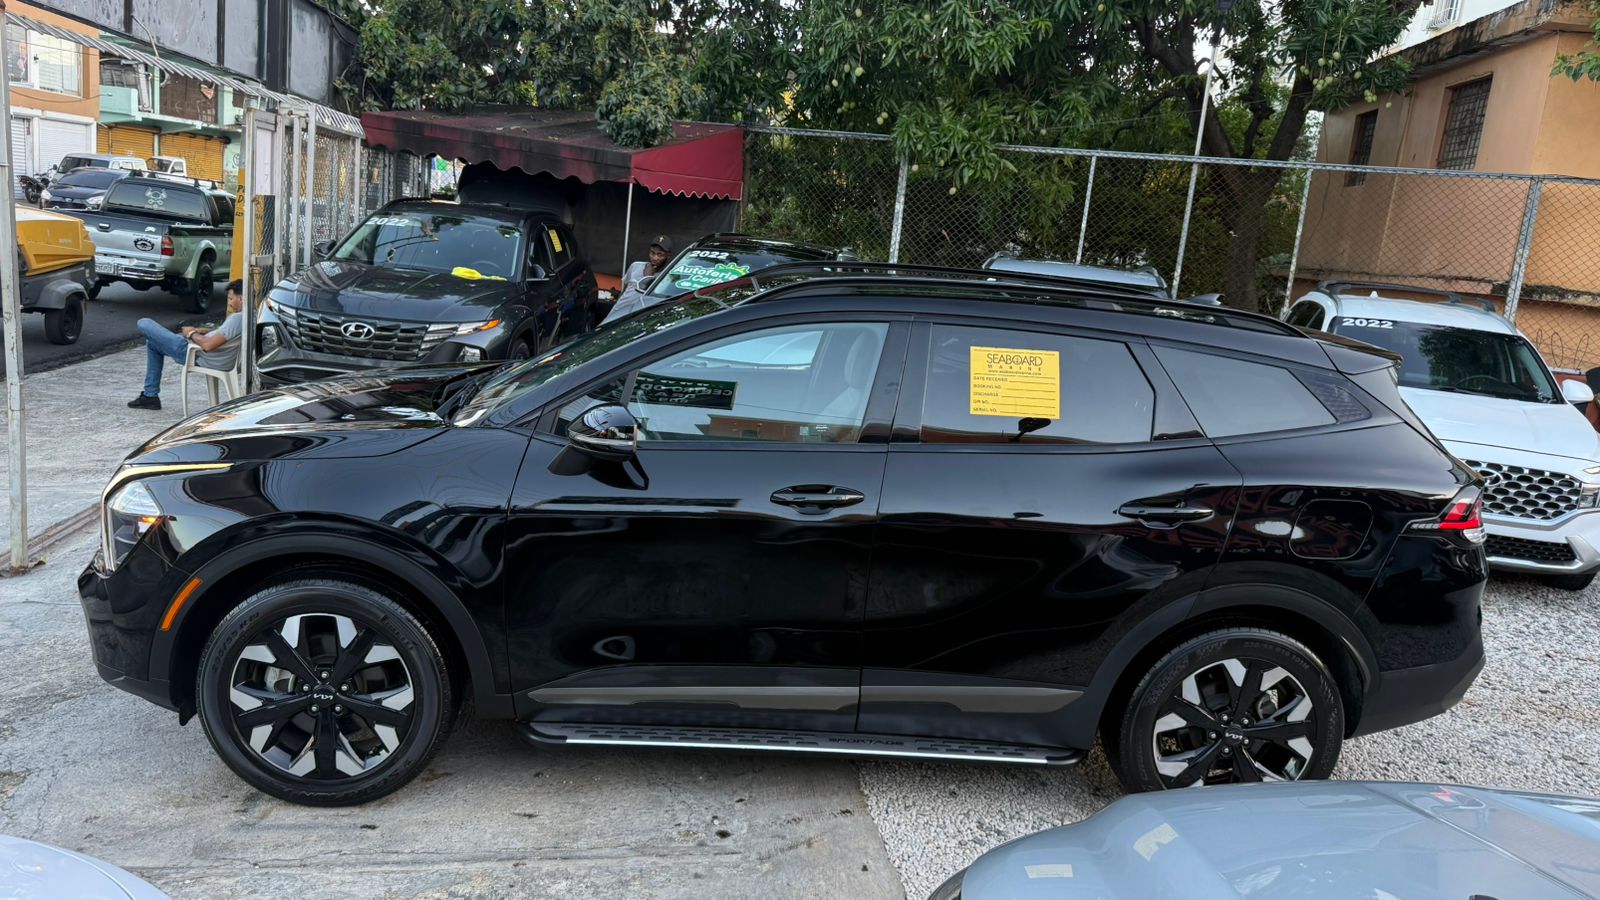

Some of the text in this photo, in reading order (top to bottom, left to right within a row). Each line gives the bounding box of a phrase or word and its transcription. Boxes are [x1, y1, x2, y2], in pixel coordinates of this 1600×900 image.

[365, 217, 409, 227] 2022
[689, 250, 729, 260] 2022
[674, 265, 738, 281] Autoferia
[1342, 318, 1393, 329] 2022
[986, 353, 1043, 367] SEABOARD
[987, 364, 1042, 372] MARINE
